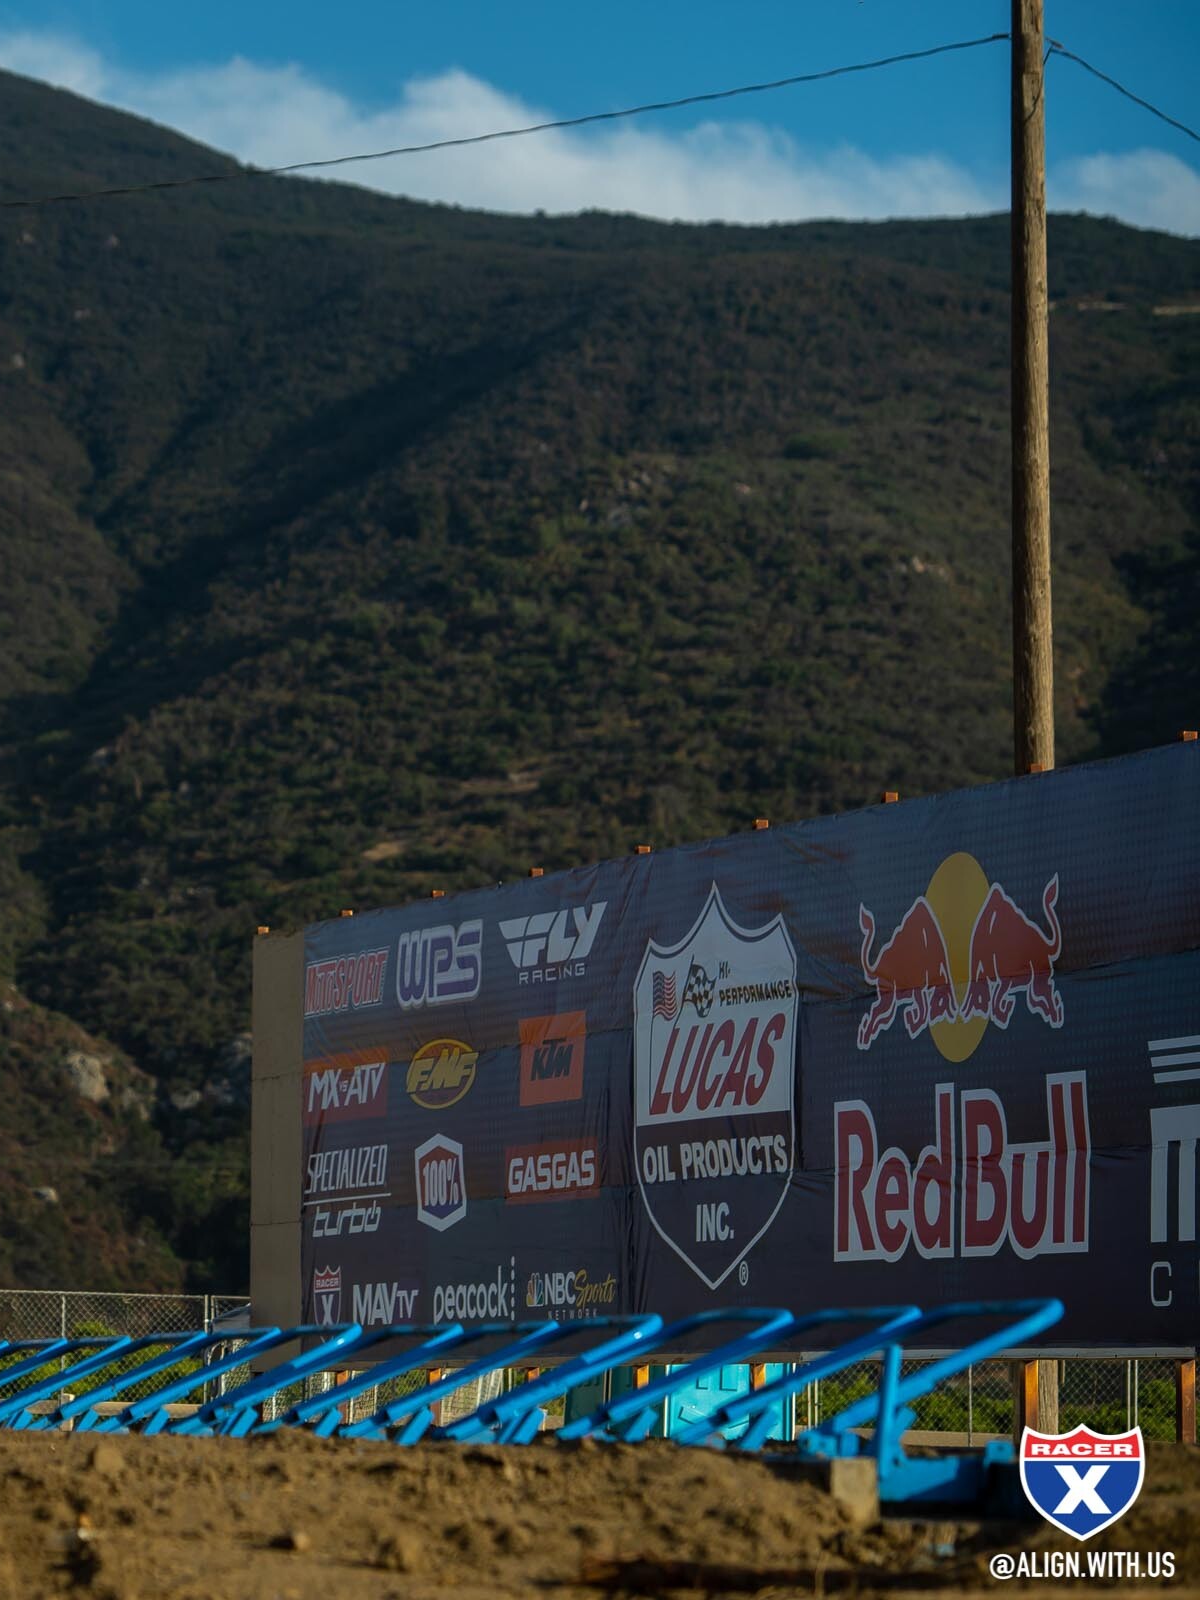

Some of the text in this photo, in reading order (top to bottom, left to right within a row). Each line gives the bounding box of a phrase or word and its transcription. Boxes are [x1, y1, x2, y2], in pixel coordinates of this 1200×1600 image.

[499, 901, 608, 968] FLY
[396, 919, 483, 1010] WPS
[518, 962, 586, 985] RACING
[718, 979, 792, 1006] PERFORMANCE
[530, 1037, 573, 1081] KTM
[650, 1012, 787, 1116] LUCAS
[308, 1067, 341, 1112] MX
[344, 1062, 386, 1107] ATV
[304, 1144, 388, 1194] SPECIALIZED
[508, 1149, 595, 1194] GASGAS
[643, 1134, 788, 1184] OIL PRODUCTS
[834, 1082, 954, 1263] Red
[961, 1070, 1091, 1260] Bull
[423, 1158, 459, 1207] 100%
[312, 1200, 382, 1237] turbo
[696, 1202, 735, 1242] INC.
[315, 1277, 339, 1289] RACER
[433, 1265, 509, 1326] peacock
[545, 1269, 617, 1310] NBC Sports
[321, 1294, 334, 1326] X
[548, 1308, 598, 1321] NETWORK
